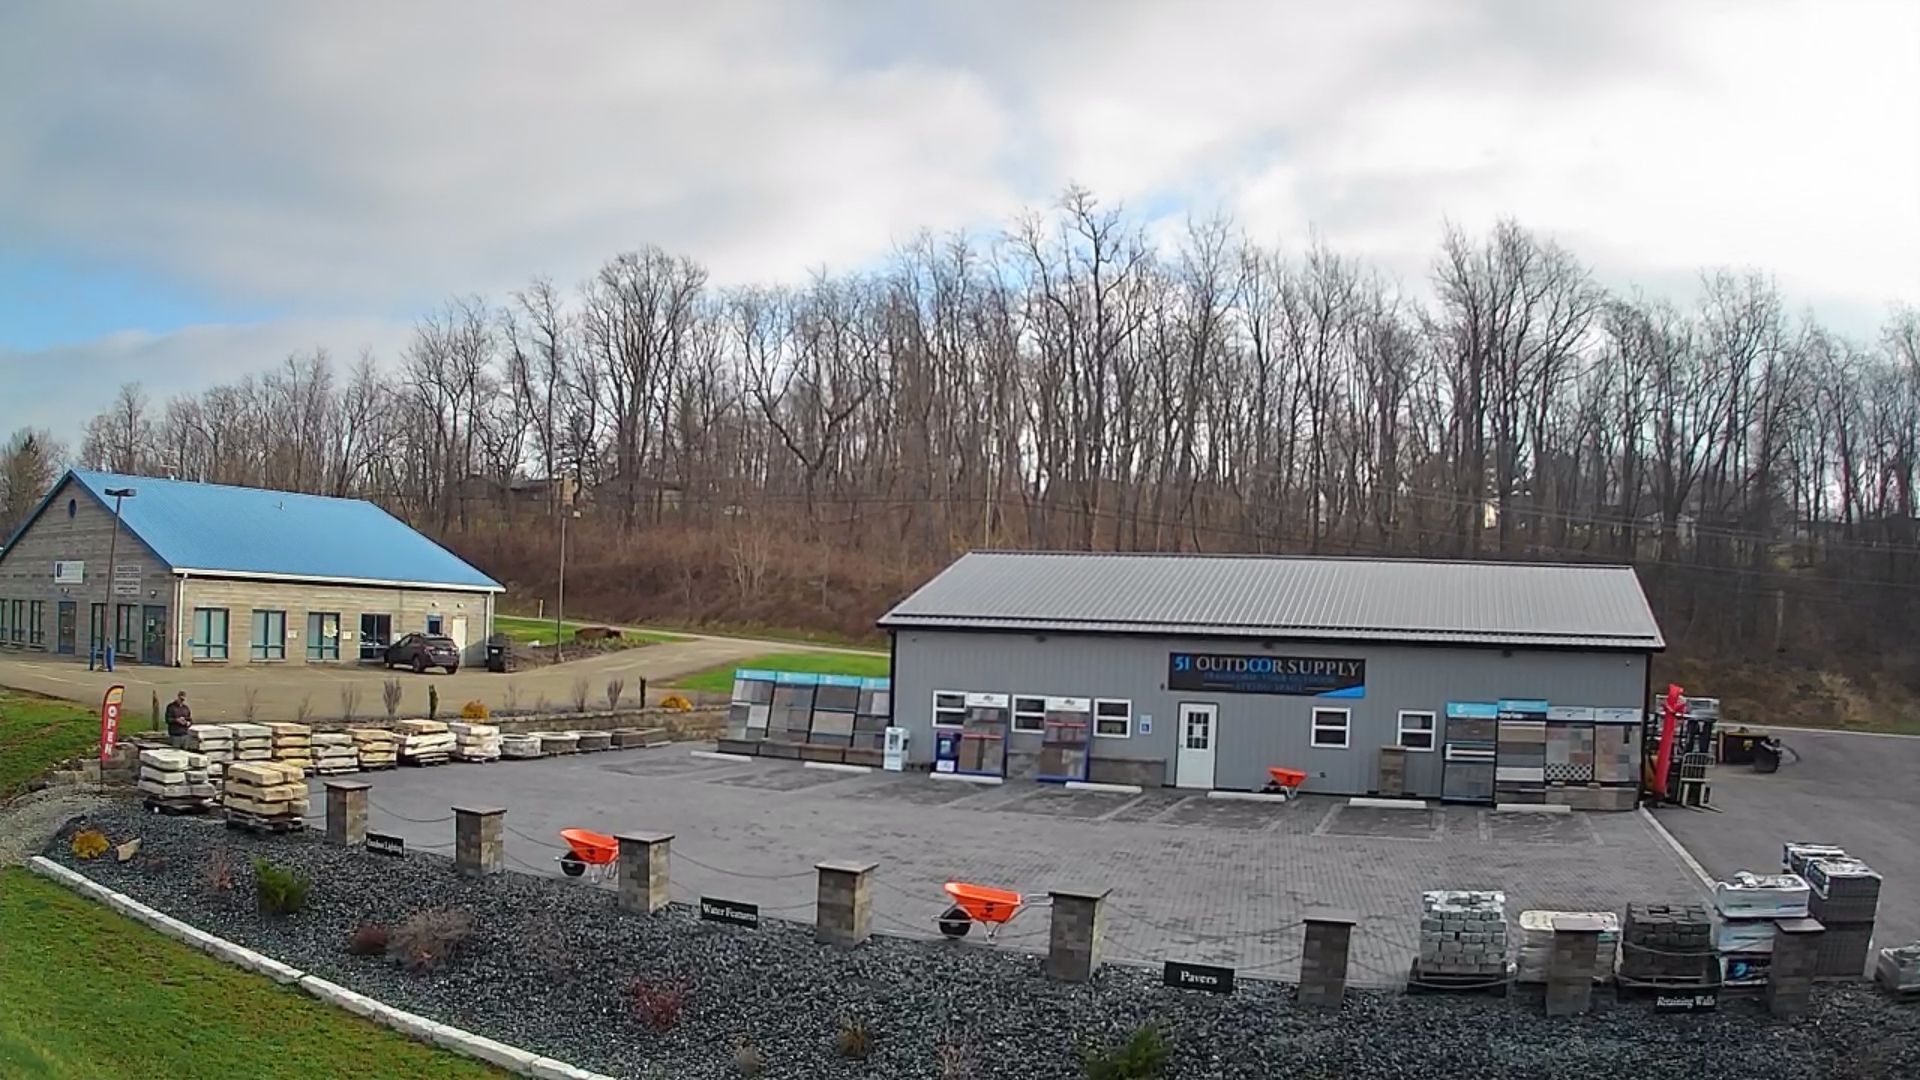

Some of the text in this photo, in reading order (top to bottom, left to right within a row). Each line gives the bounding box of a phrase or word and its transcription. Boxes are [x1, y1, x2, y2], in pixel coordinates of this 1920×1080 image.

[1174, 656, 1361, 677] 51 OUTDOOR SUPPLY
[104, 705, 118, 756] OPEN
[702, 903, 757, 921] Water Features
[1180, 970, 1218, 985] Pavers
[1656, 995, 1716, 1009] Retaining Walls
